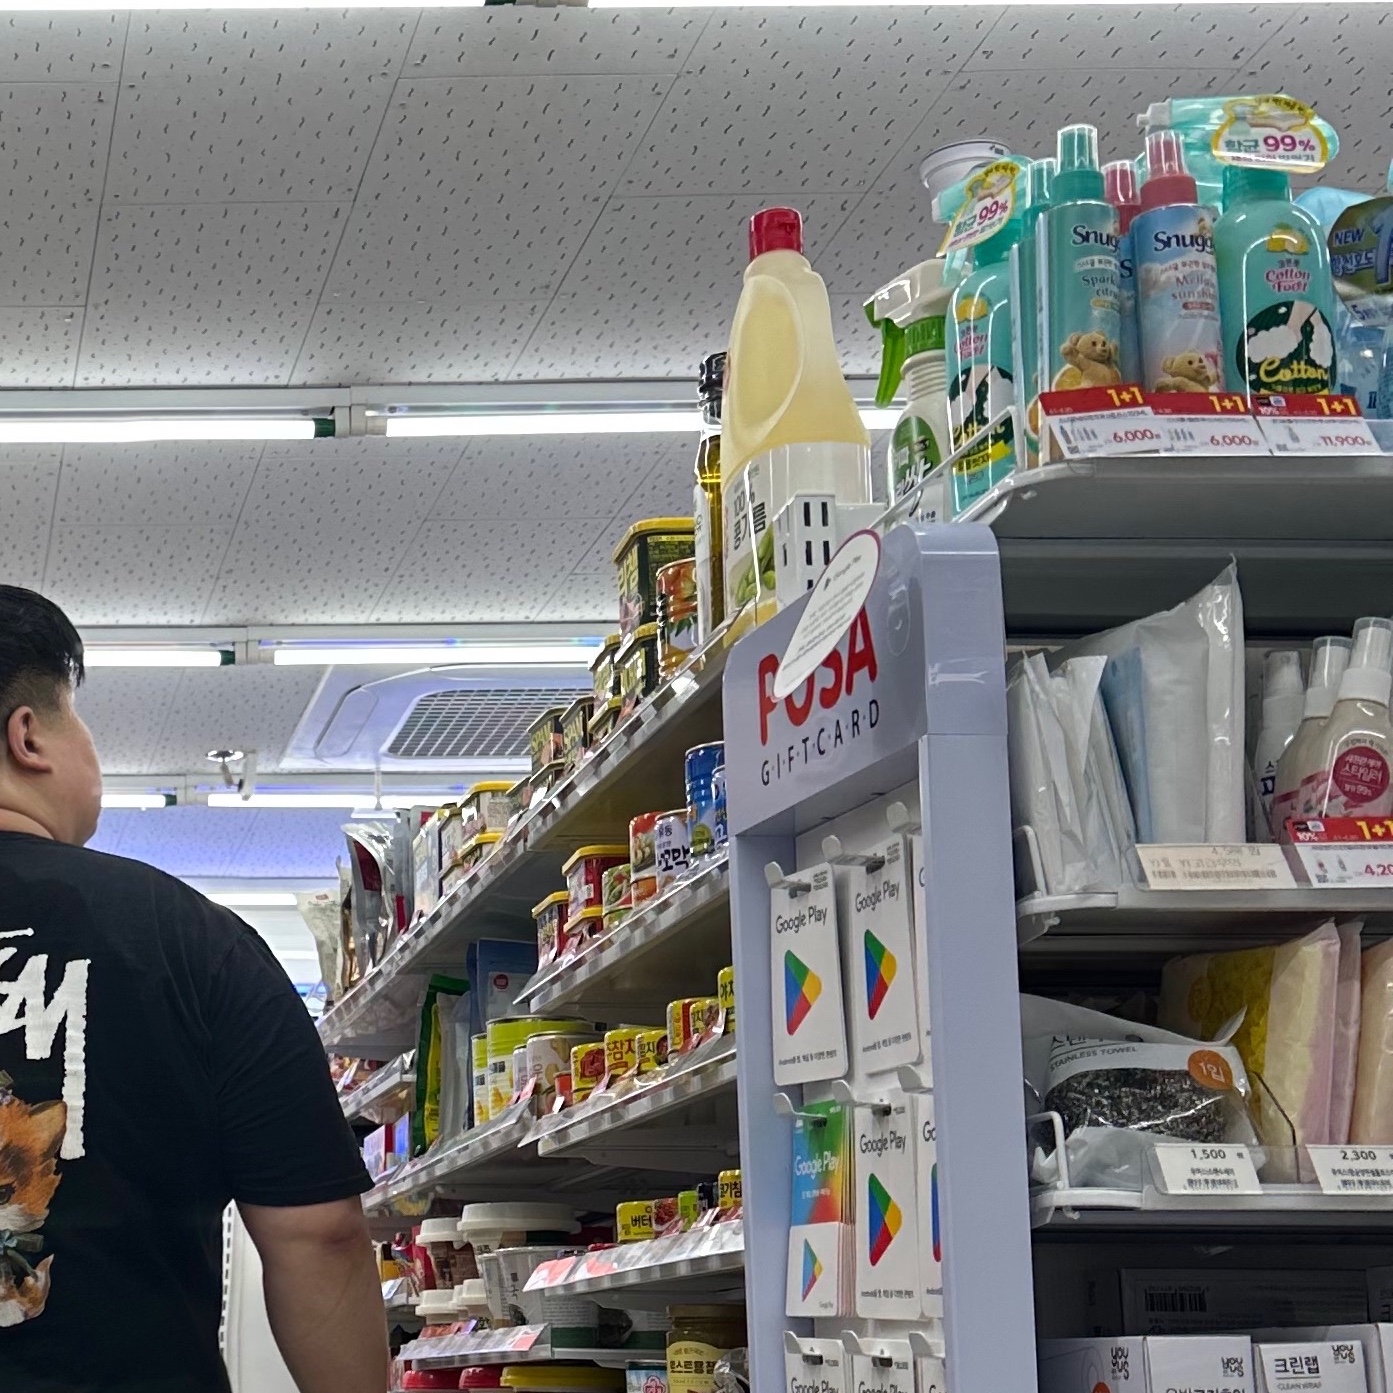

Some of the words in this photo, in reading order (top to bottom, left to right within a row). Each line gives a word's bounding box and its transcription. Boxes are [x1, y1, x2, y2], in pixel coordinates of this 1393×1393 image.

[1071, 226, 1121, 252] Snug
[1334, 227, 1364, 246] NEW
[1259, 355, 1328, 382] Cotton
[1107, 386, 1144, 407] 1+1
[1208, 395, 1247, 413] 1+1
[1316, 397, 1357, 416] 1+1
[1112, 428, 1154, 445] 6,000
[1210, 435, 1253, 448] 6,000
[1319, 434, 1366, 448] 11,900
[855, 886, 879, 913] Google
[880, 880, 900, 905] Play
[776, 908, 808, 936] Google
[809, 904, 828, 927] Play
[860, 1133, 883, 1157] Google
[883, 1129, 906, 1154] Play
[1190, 1148, 1226, 1161] 1,500
[1341, 1149, 1377, 1161] 2,300
[794, 1154, 823, 1179] Google
[1274, 1356, 1321, 1376] 크린랩
